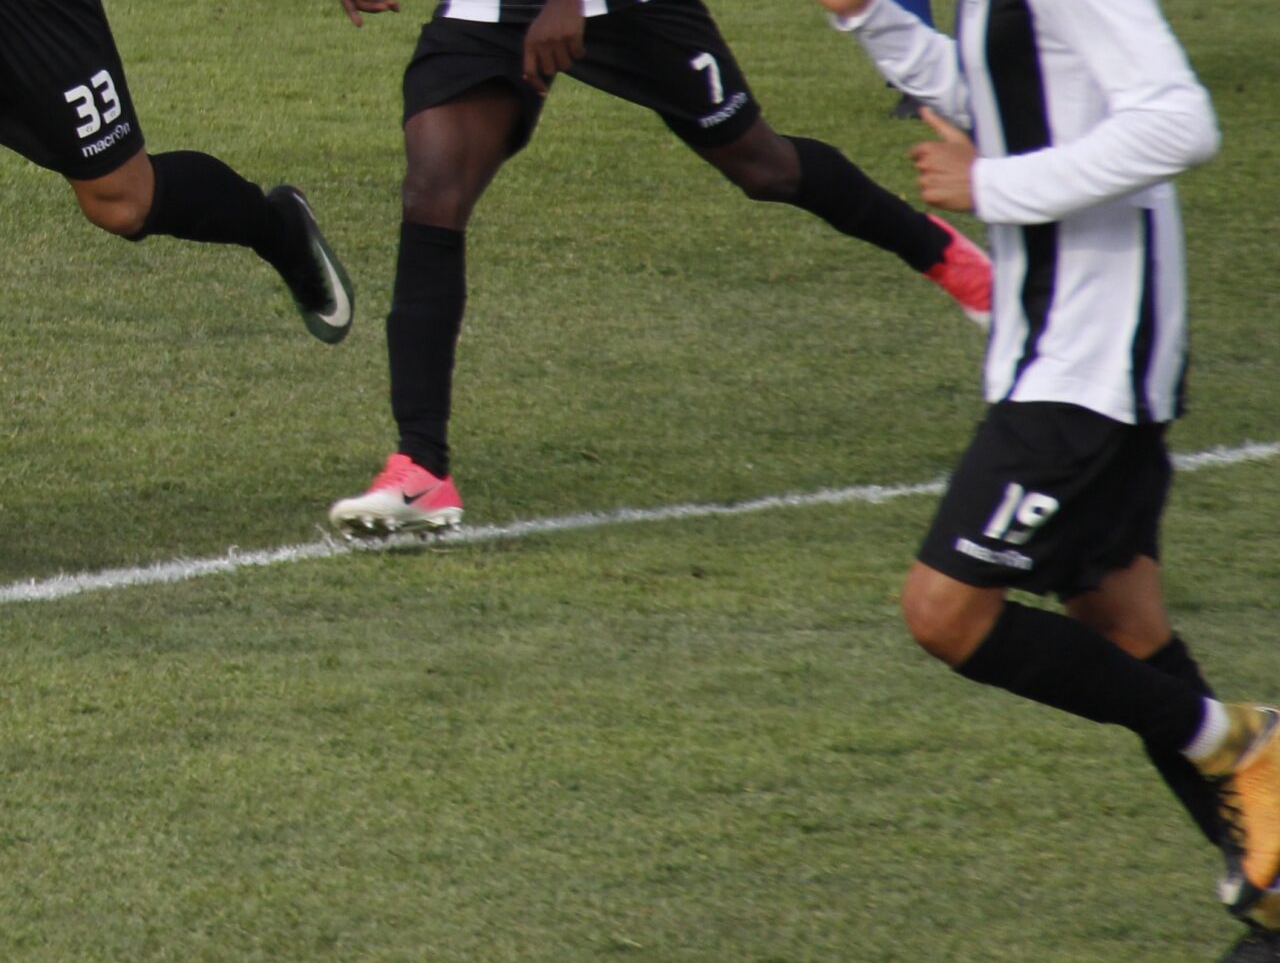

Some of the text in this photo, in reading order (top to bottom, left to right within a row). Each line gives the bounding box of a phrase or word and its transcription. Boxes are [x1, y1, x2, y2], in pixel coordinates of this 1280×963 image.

[64, 69, 121, 138] 33
[691, 52, 724, 104] 7
[983, 482, 1059, 545] 19
